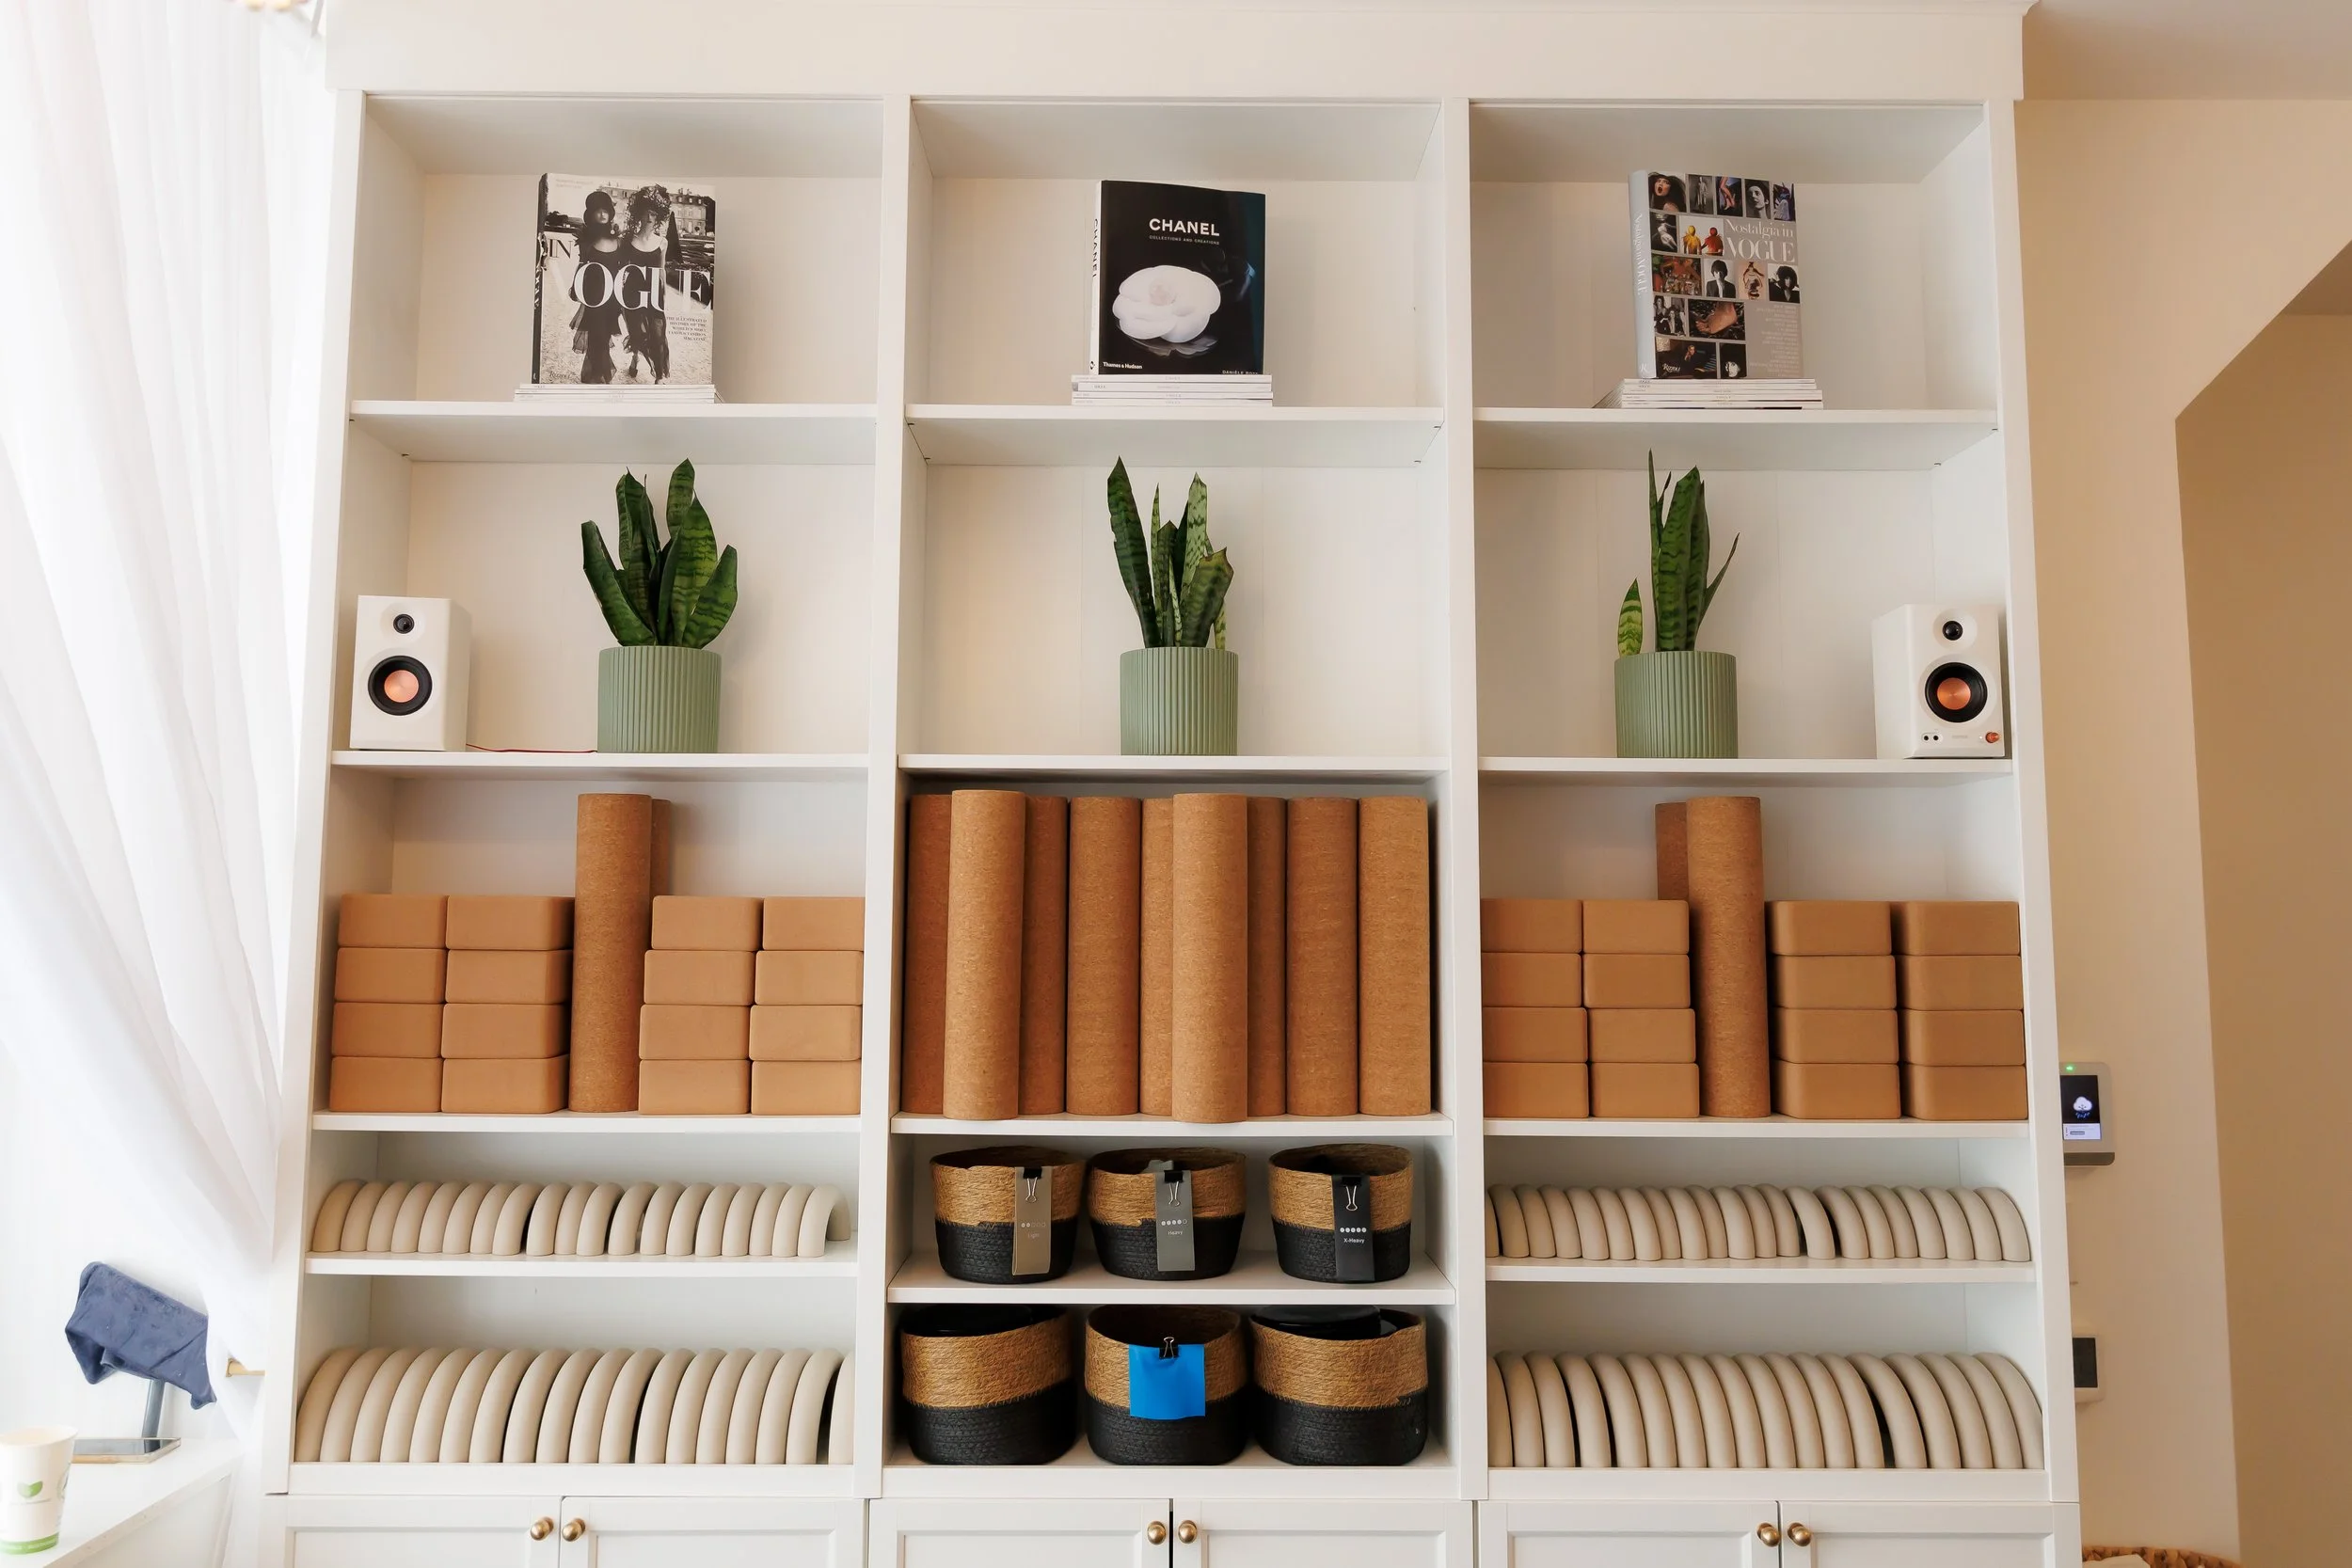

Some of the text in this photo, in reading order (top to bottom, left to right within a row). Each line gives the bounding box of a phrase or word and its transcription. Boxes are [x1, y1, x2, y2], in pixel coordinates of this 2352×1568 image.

[1150, 218, 1220, 237] CHANEL
[1725, 218, 1794, 239] Nostalgia in
[548, 238, 574, 260] IN
[1726, 236, 1796, 263] VOGUE
